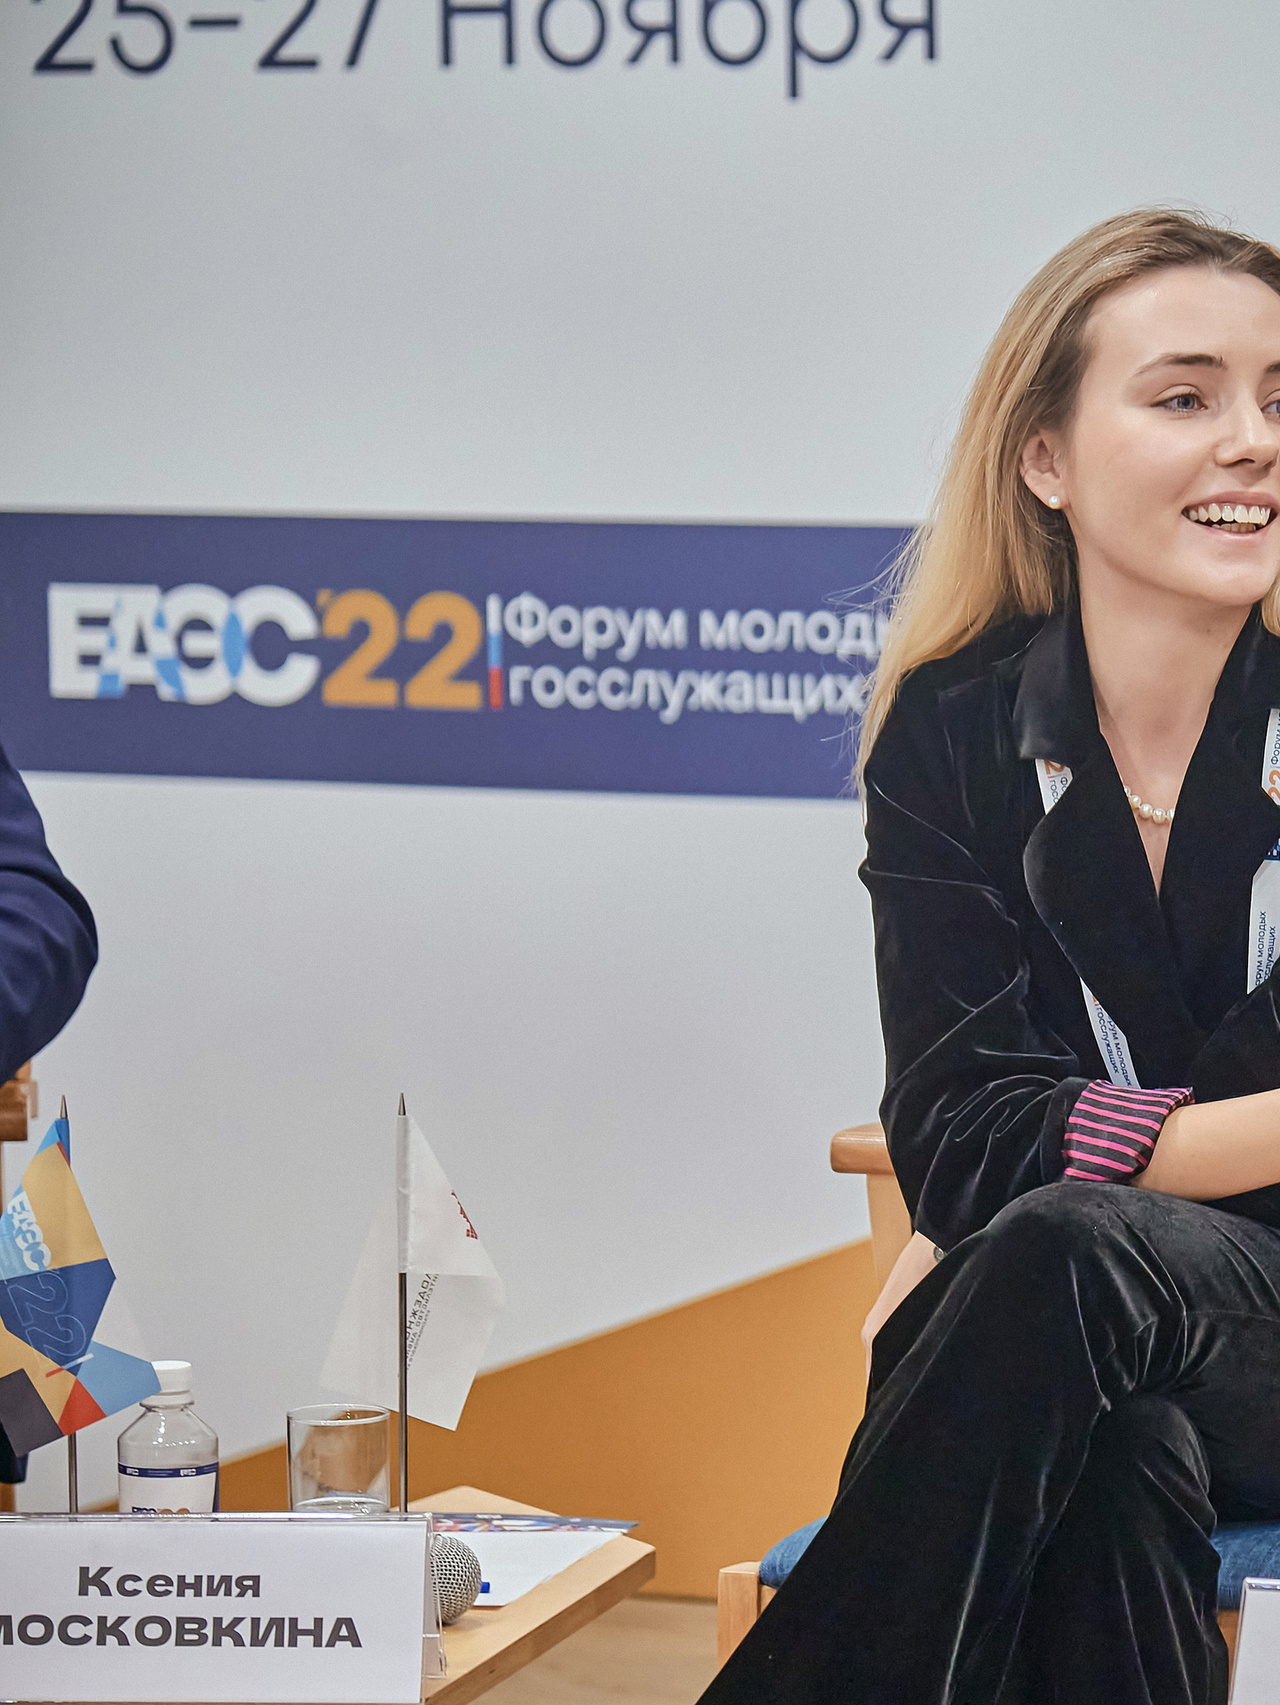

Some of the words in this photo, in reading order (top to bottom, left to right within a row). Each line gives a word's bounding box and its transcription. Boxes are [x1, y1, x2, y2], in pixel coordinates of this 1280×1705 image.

[437, 0, 941, 100] Ноября
[503, 591, 688, 662] Форум
[1256, 911, 1267, 958] молодых
[1096, 1007, 1120, 1074] госслужащих
[1114, 1040, 1133, 1087] молодых
[77, 1566, 261, 1598] Ксения
